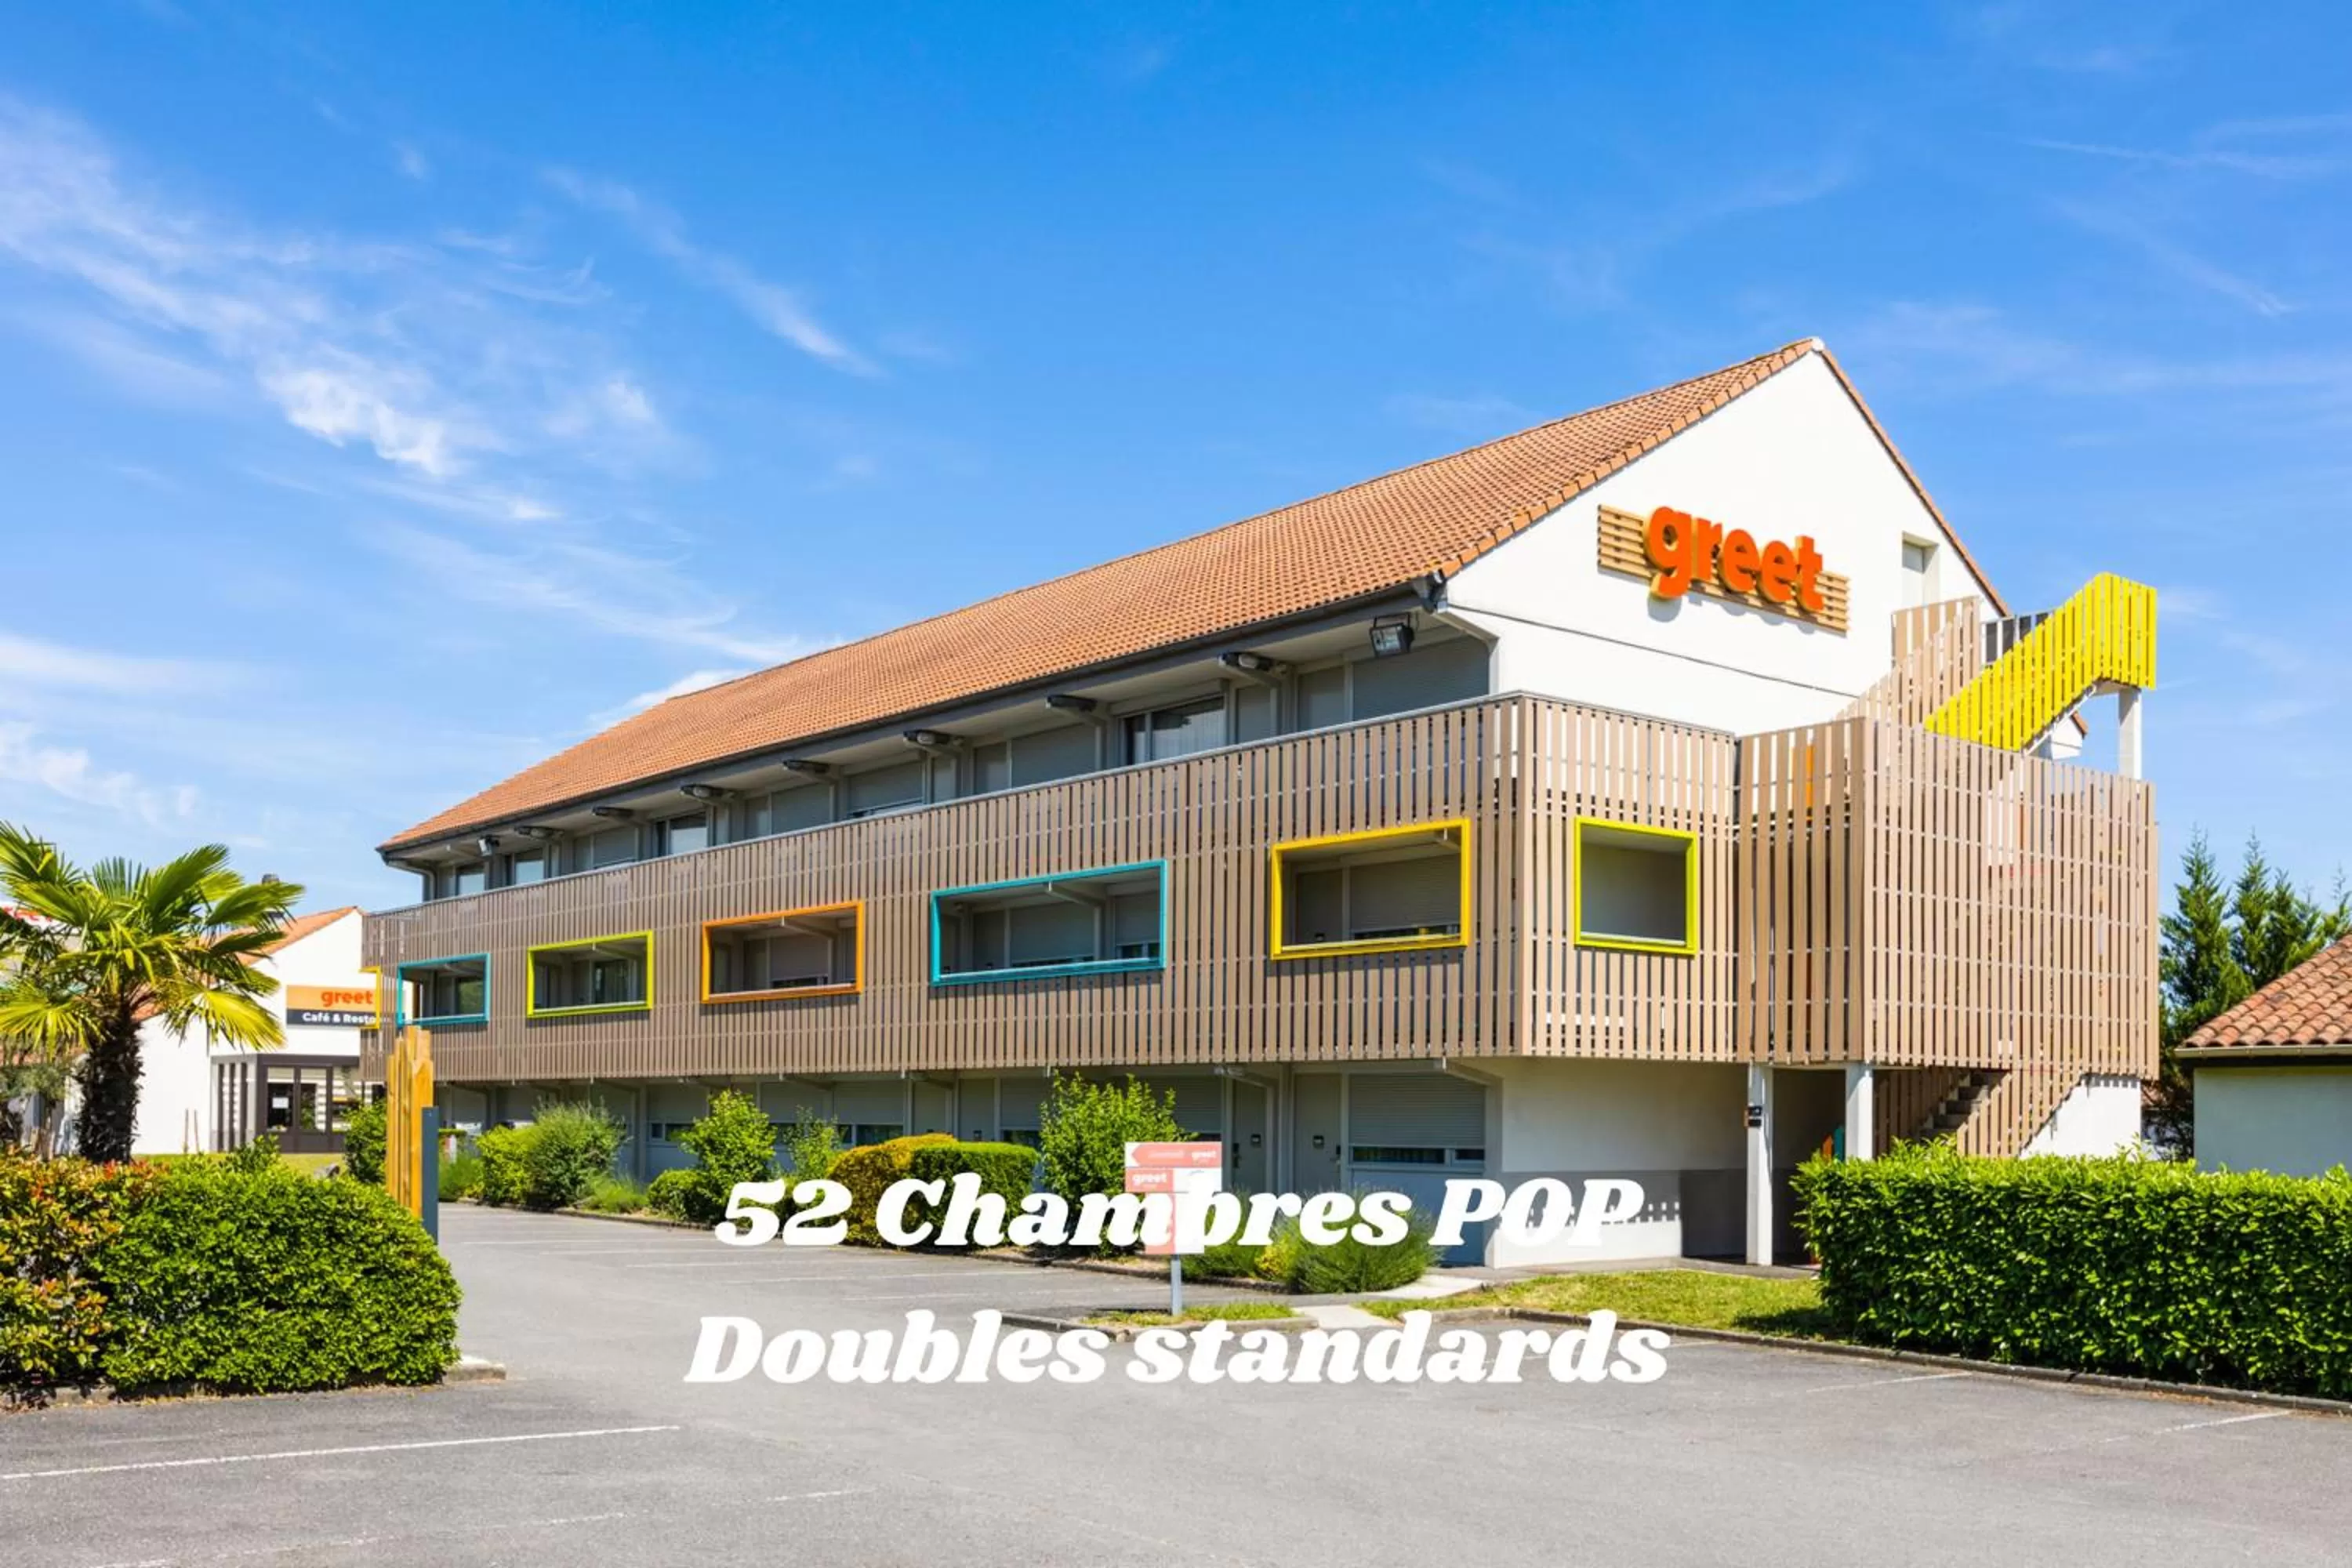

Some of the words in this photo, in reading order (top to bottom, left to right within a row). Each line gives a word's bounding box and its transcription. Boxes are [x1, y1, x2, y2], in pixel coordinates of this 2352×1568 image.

[1644, 506, 1824, 613] greet
[321, 991, 374, 1007] greet
[302, 1011, 330, 1023] Café
[332, 1013, 341, 1023] &
